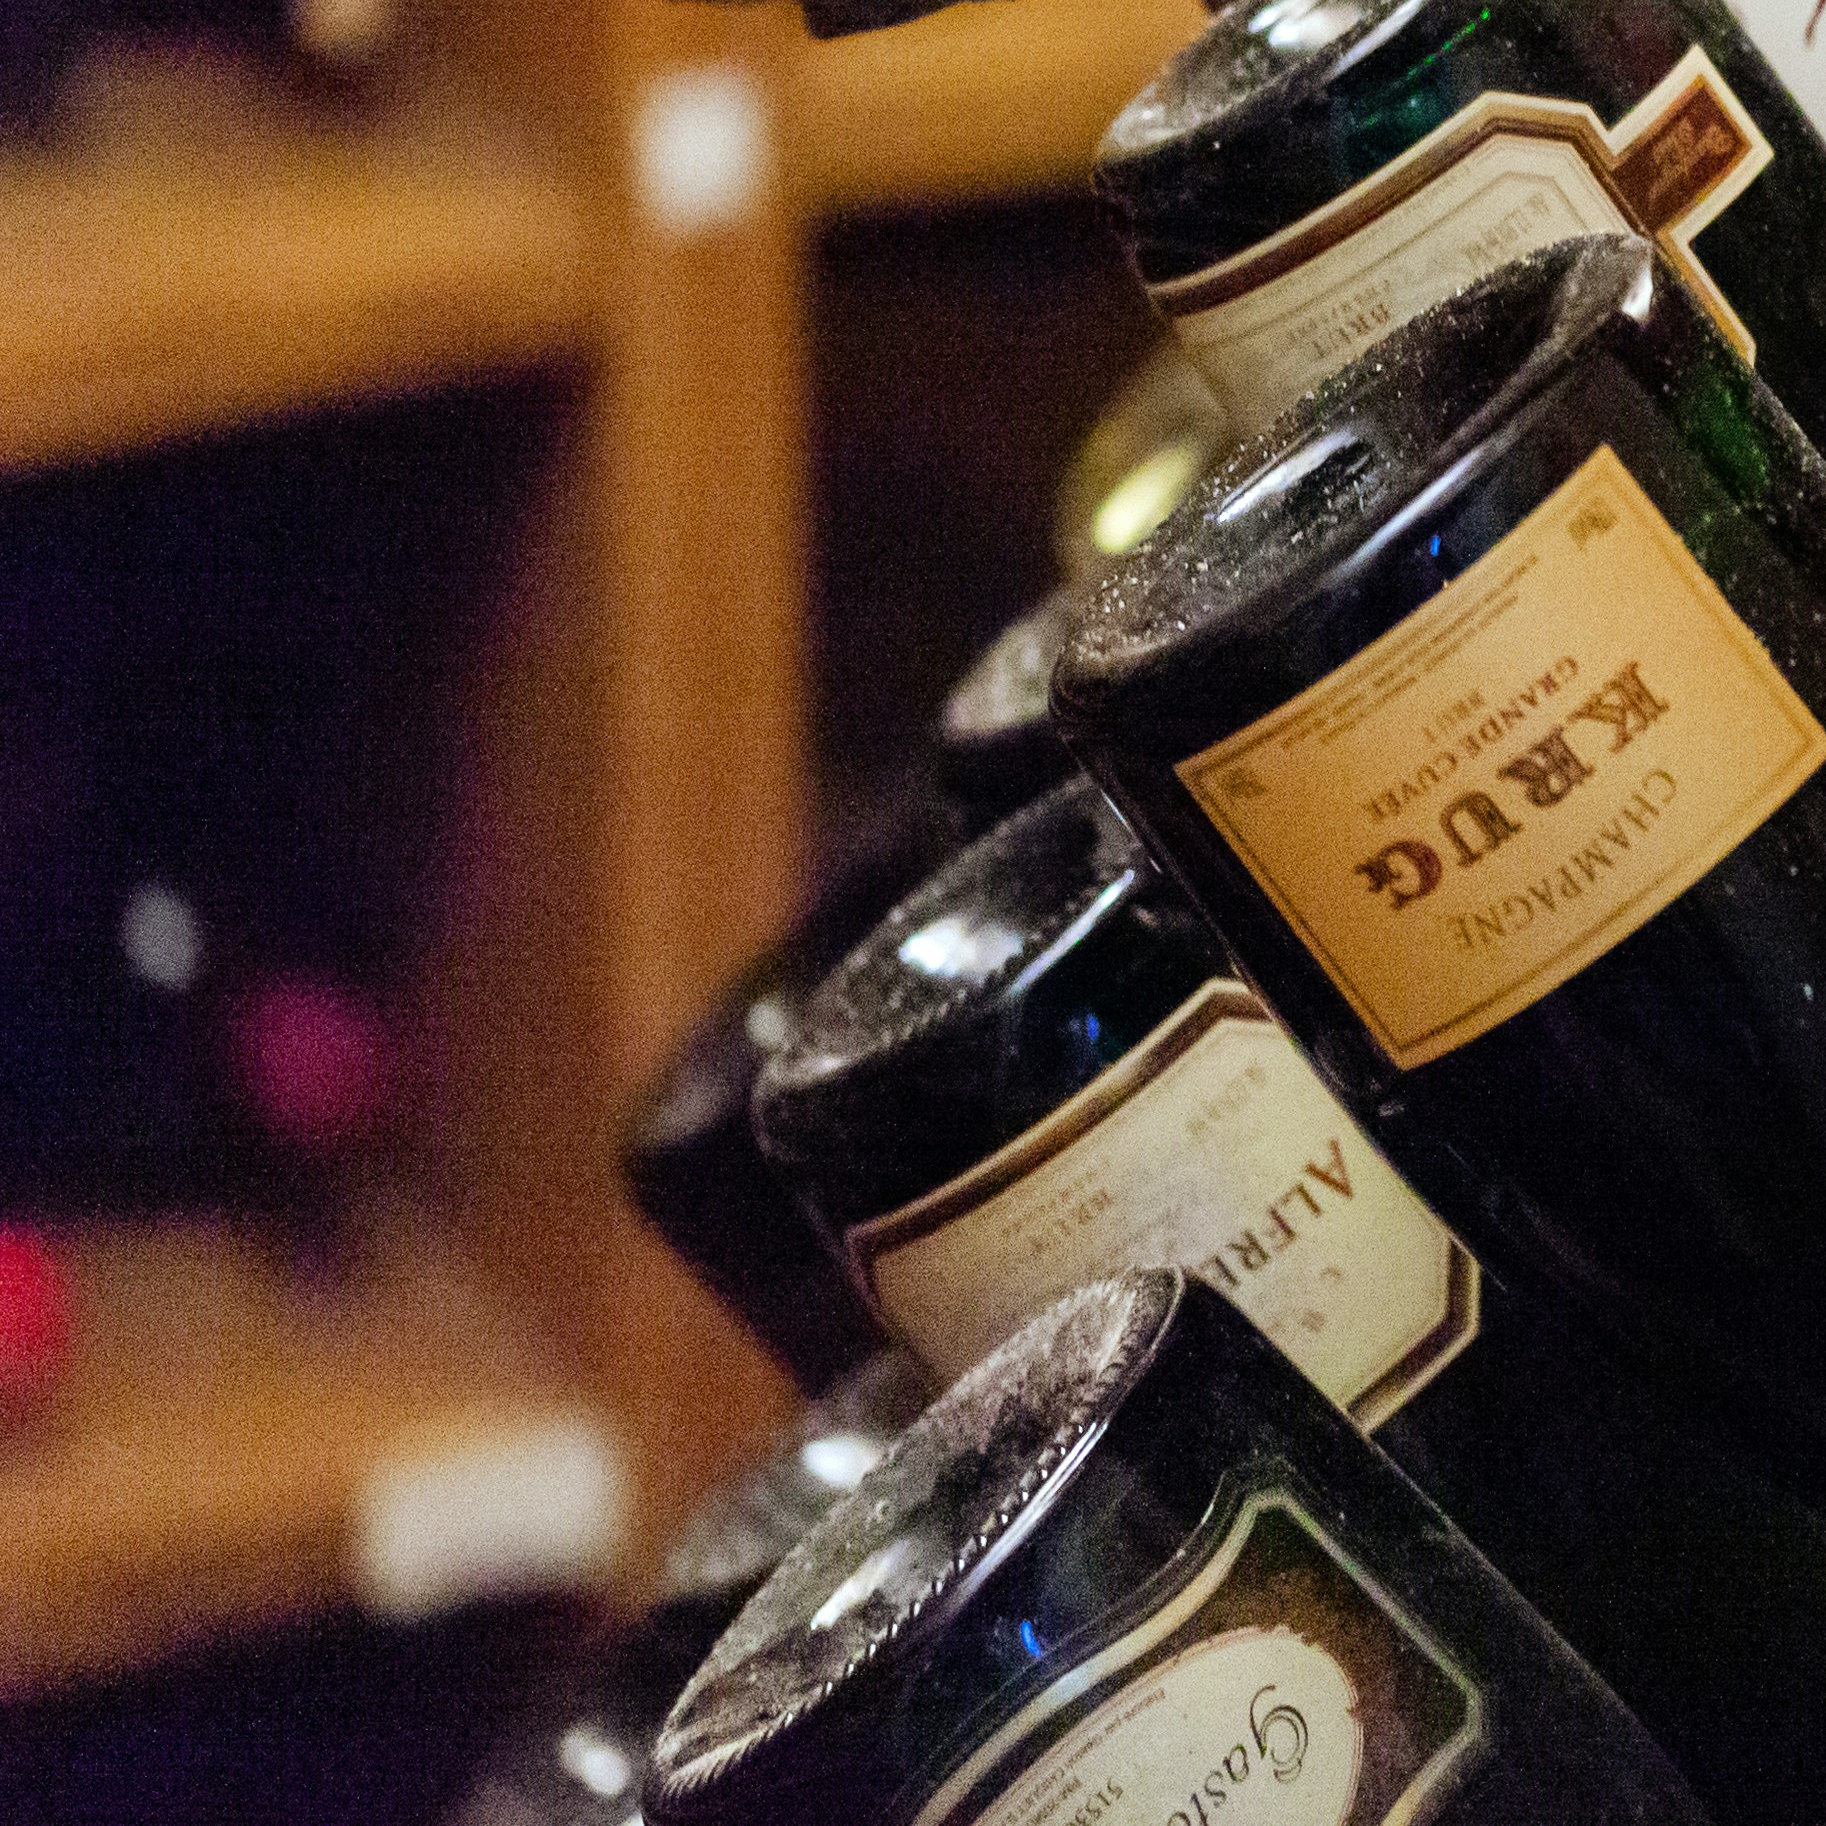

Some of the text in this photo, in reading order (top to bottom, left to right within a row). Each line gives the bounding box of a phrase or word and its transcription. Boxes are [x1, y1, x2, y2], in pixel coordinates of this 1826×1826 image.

[1354, 659, 1673, 912] KRUG
[1457, 653, 1582, 761] GRANDE
[1443, 765, 1678, 951] CHAMPAGNE
